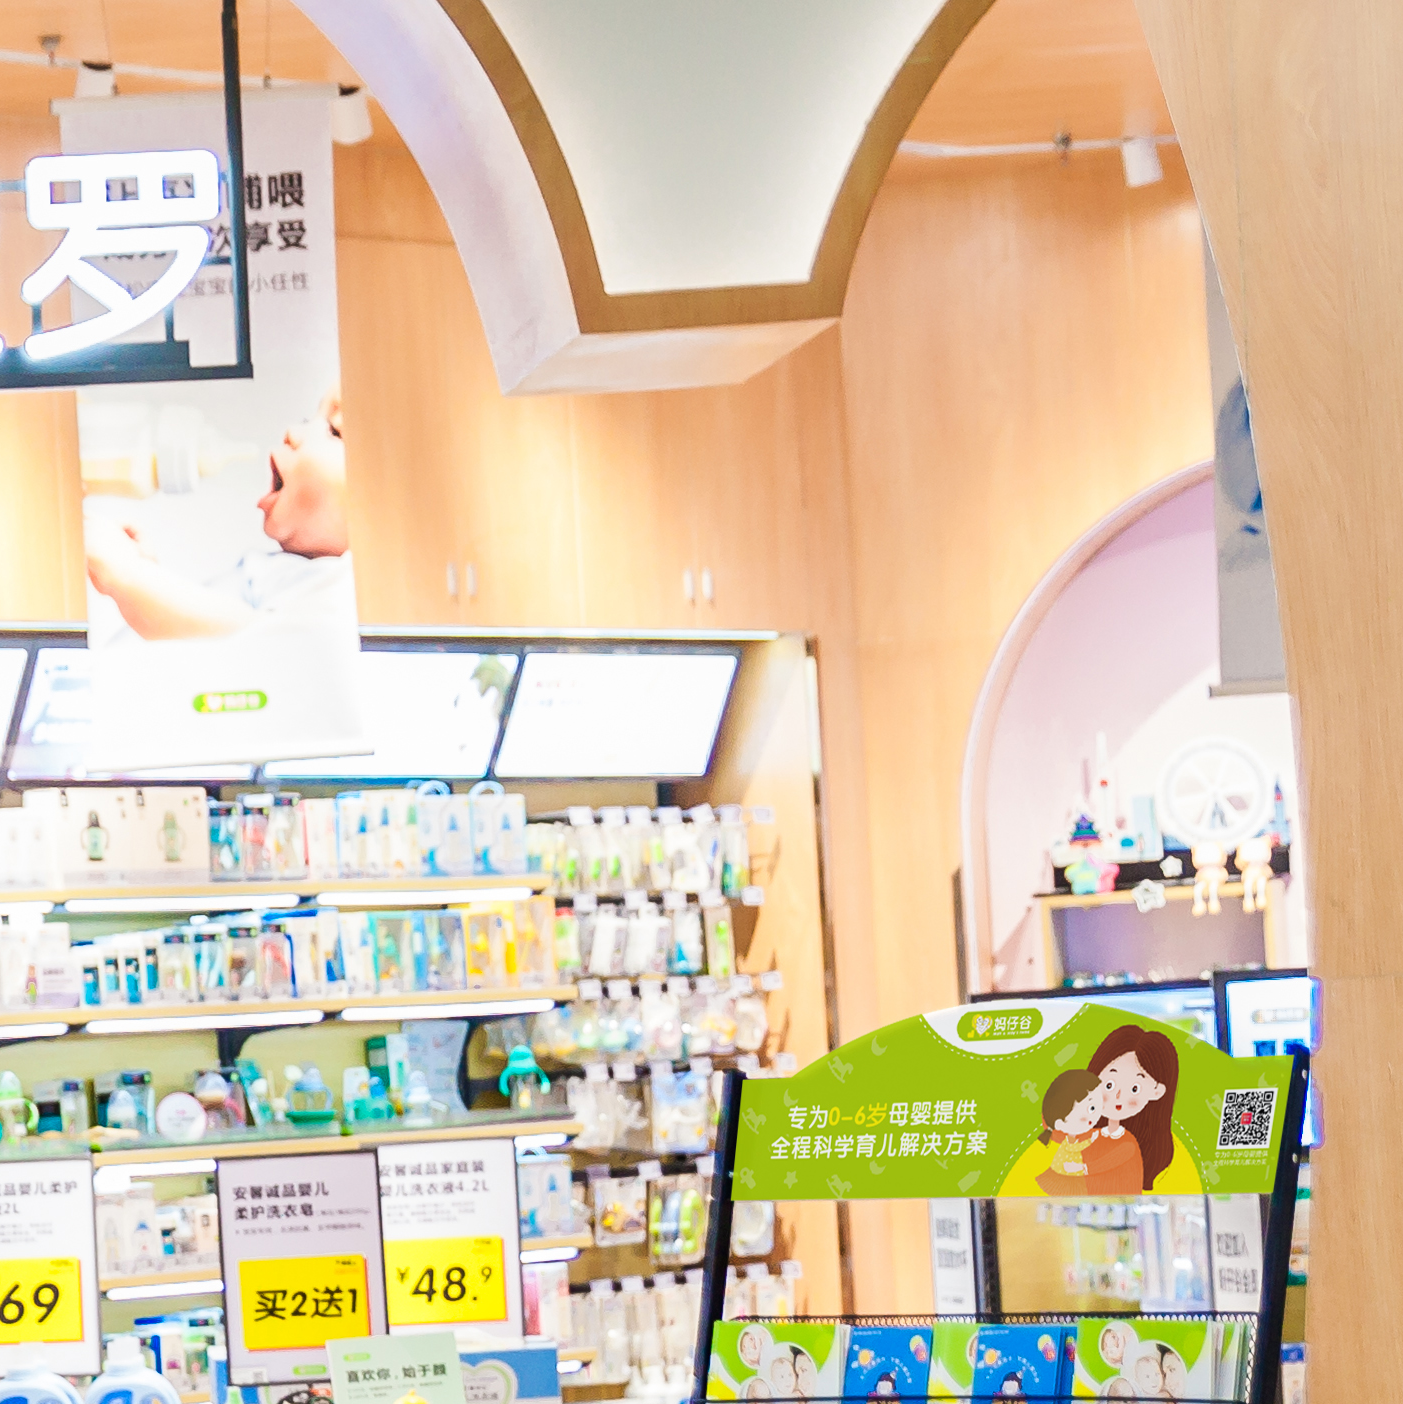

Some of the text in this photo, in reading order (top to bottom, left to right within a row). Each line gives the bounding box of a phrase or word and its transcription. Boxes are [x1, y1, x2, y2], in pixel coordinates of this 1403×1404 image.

[992, 1015, 1032, 1031] 妈仔谷
[787, 1099, 977, 1129] 专为0-6岁母婴提供
[770, 1130, 989, 1159] 全程科学育儿解决方案
[253, 1285, 358, 1323] 买2送1
